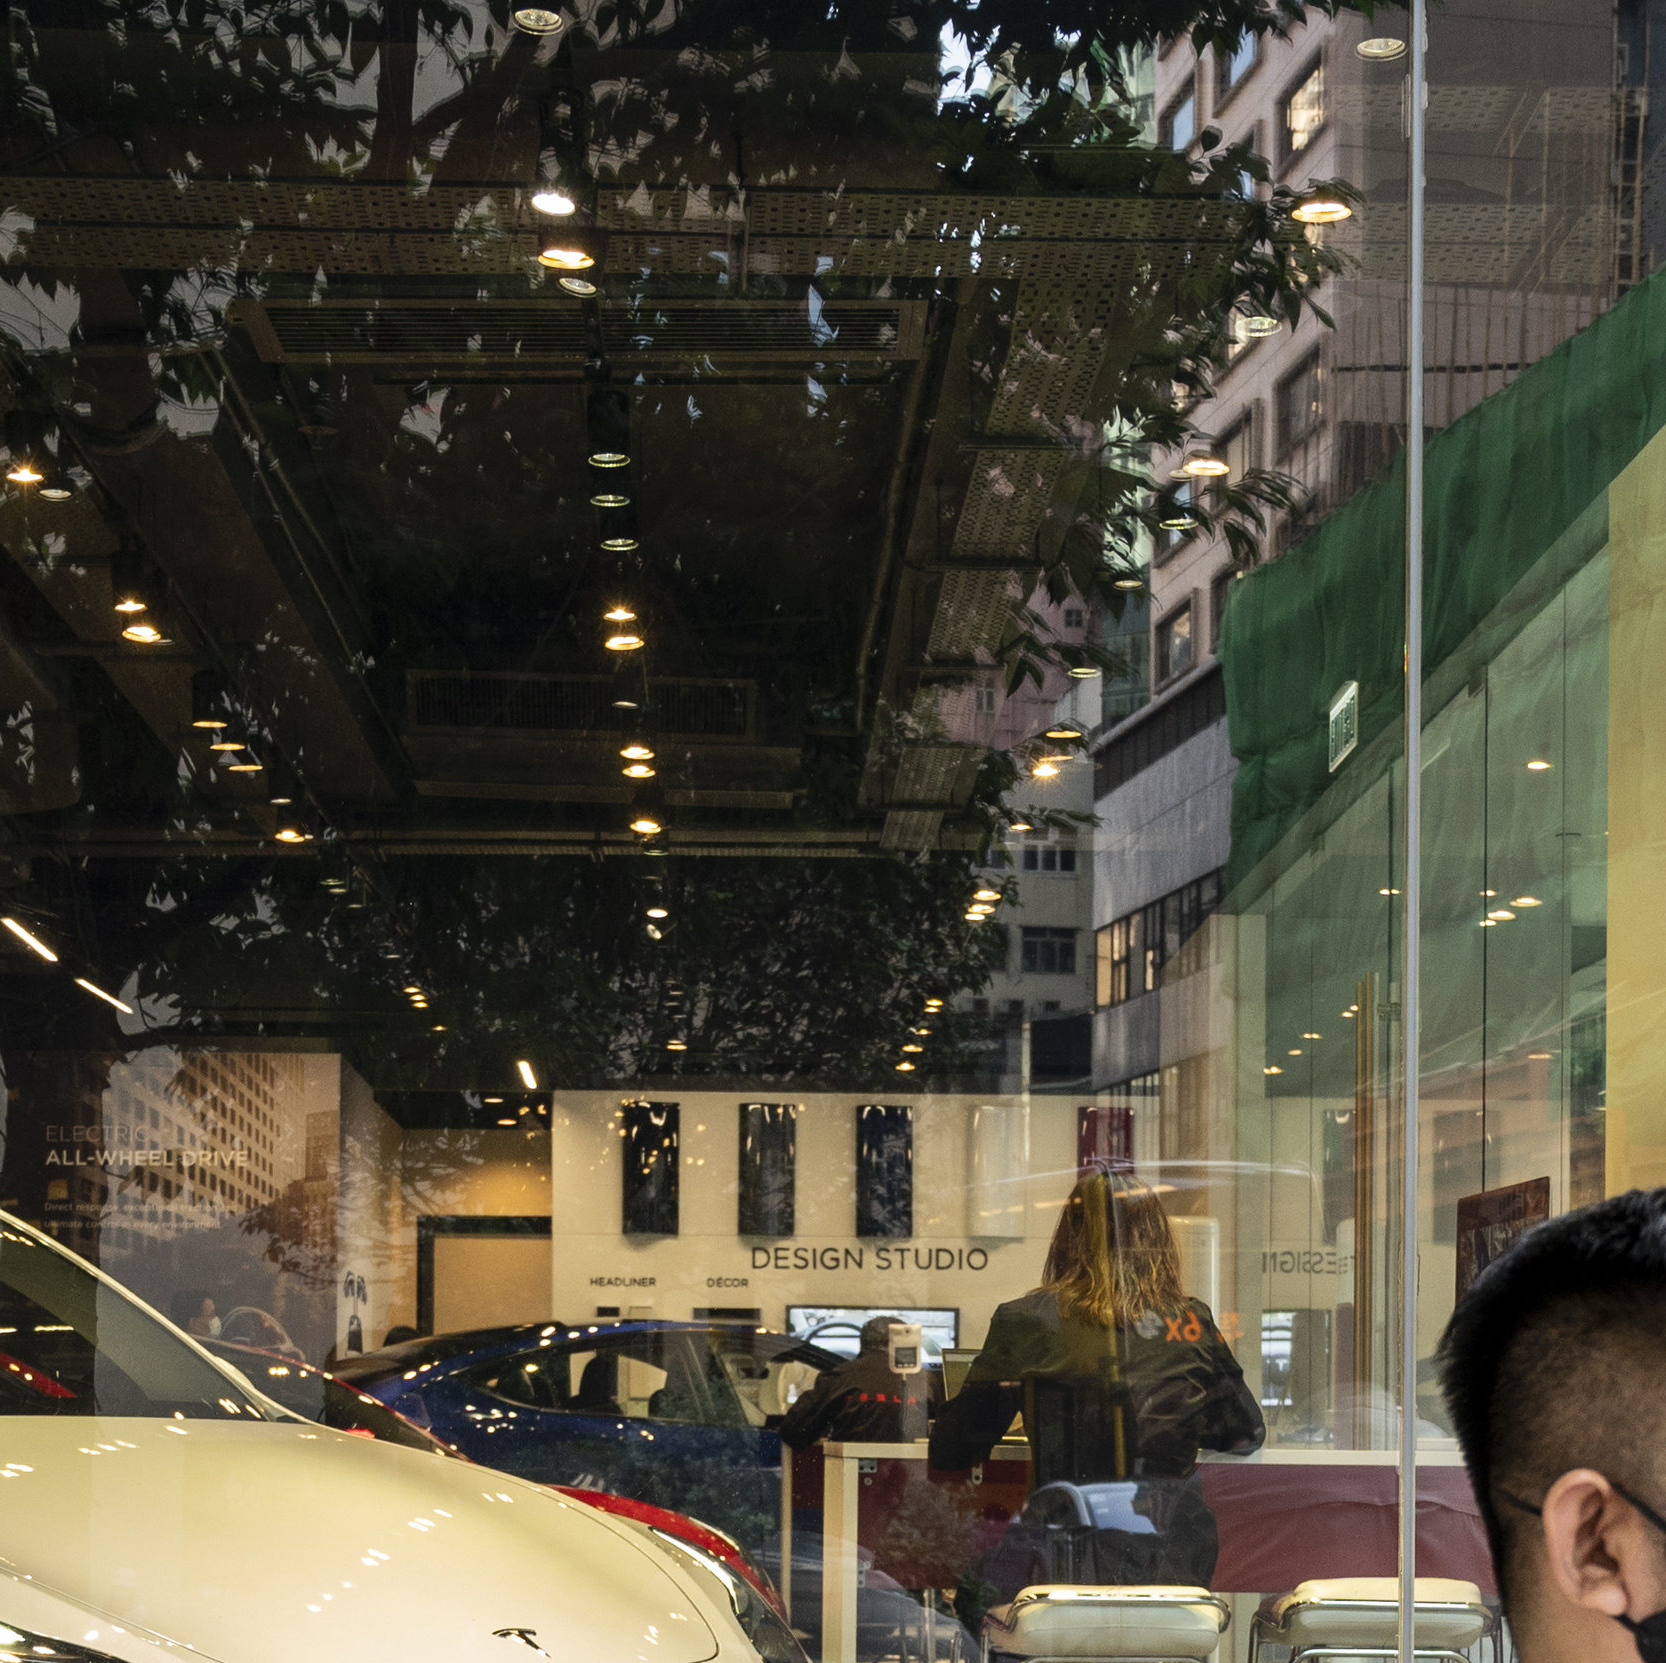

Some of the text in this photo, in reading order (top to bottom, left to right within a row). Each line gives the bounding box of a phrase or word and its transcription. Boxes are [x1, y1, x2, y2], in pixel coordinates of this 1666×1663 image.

[46, 1126, 151, 1142] ELECTRIC
[45, 1150, 249, 1167] ALL-WHEEL DRIVE
[751, 1247, 989, 1271] DESIGN STUDIO
[589, 1277, 657, 1288] HEADLINER
[706, 1275, 749, 1288] DÉCOR
